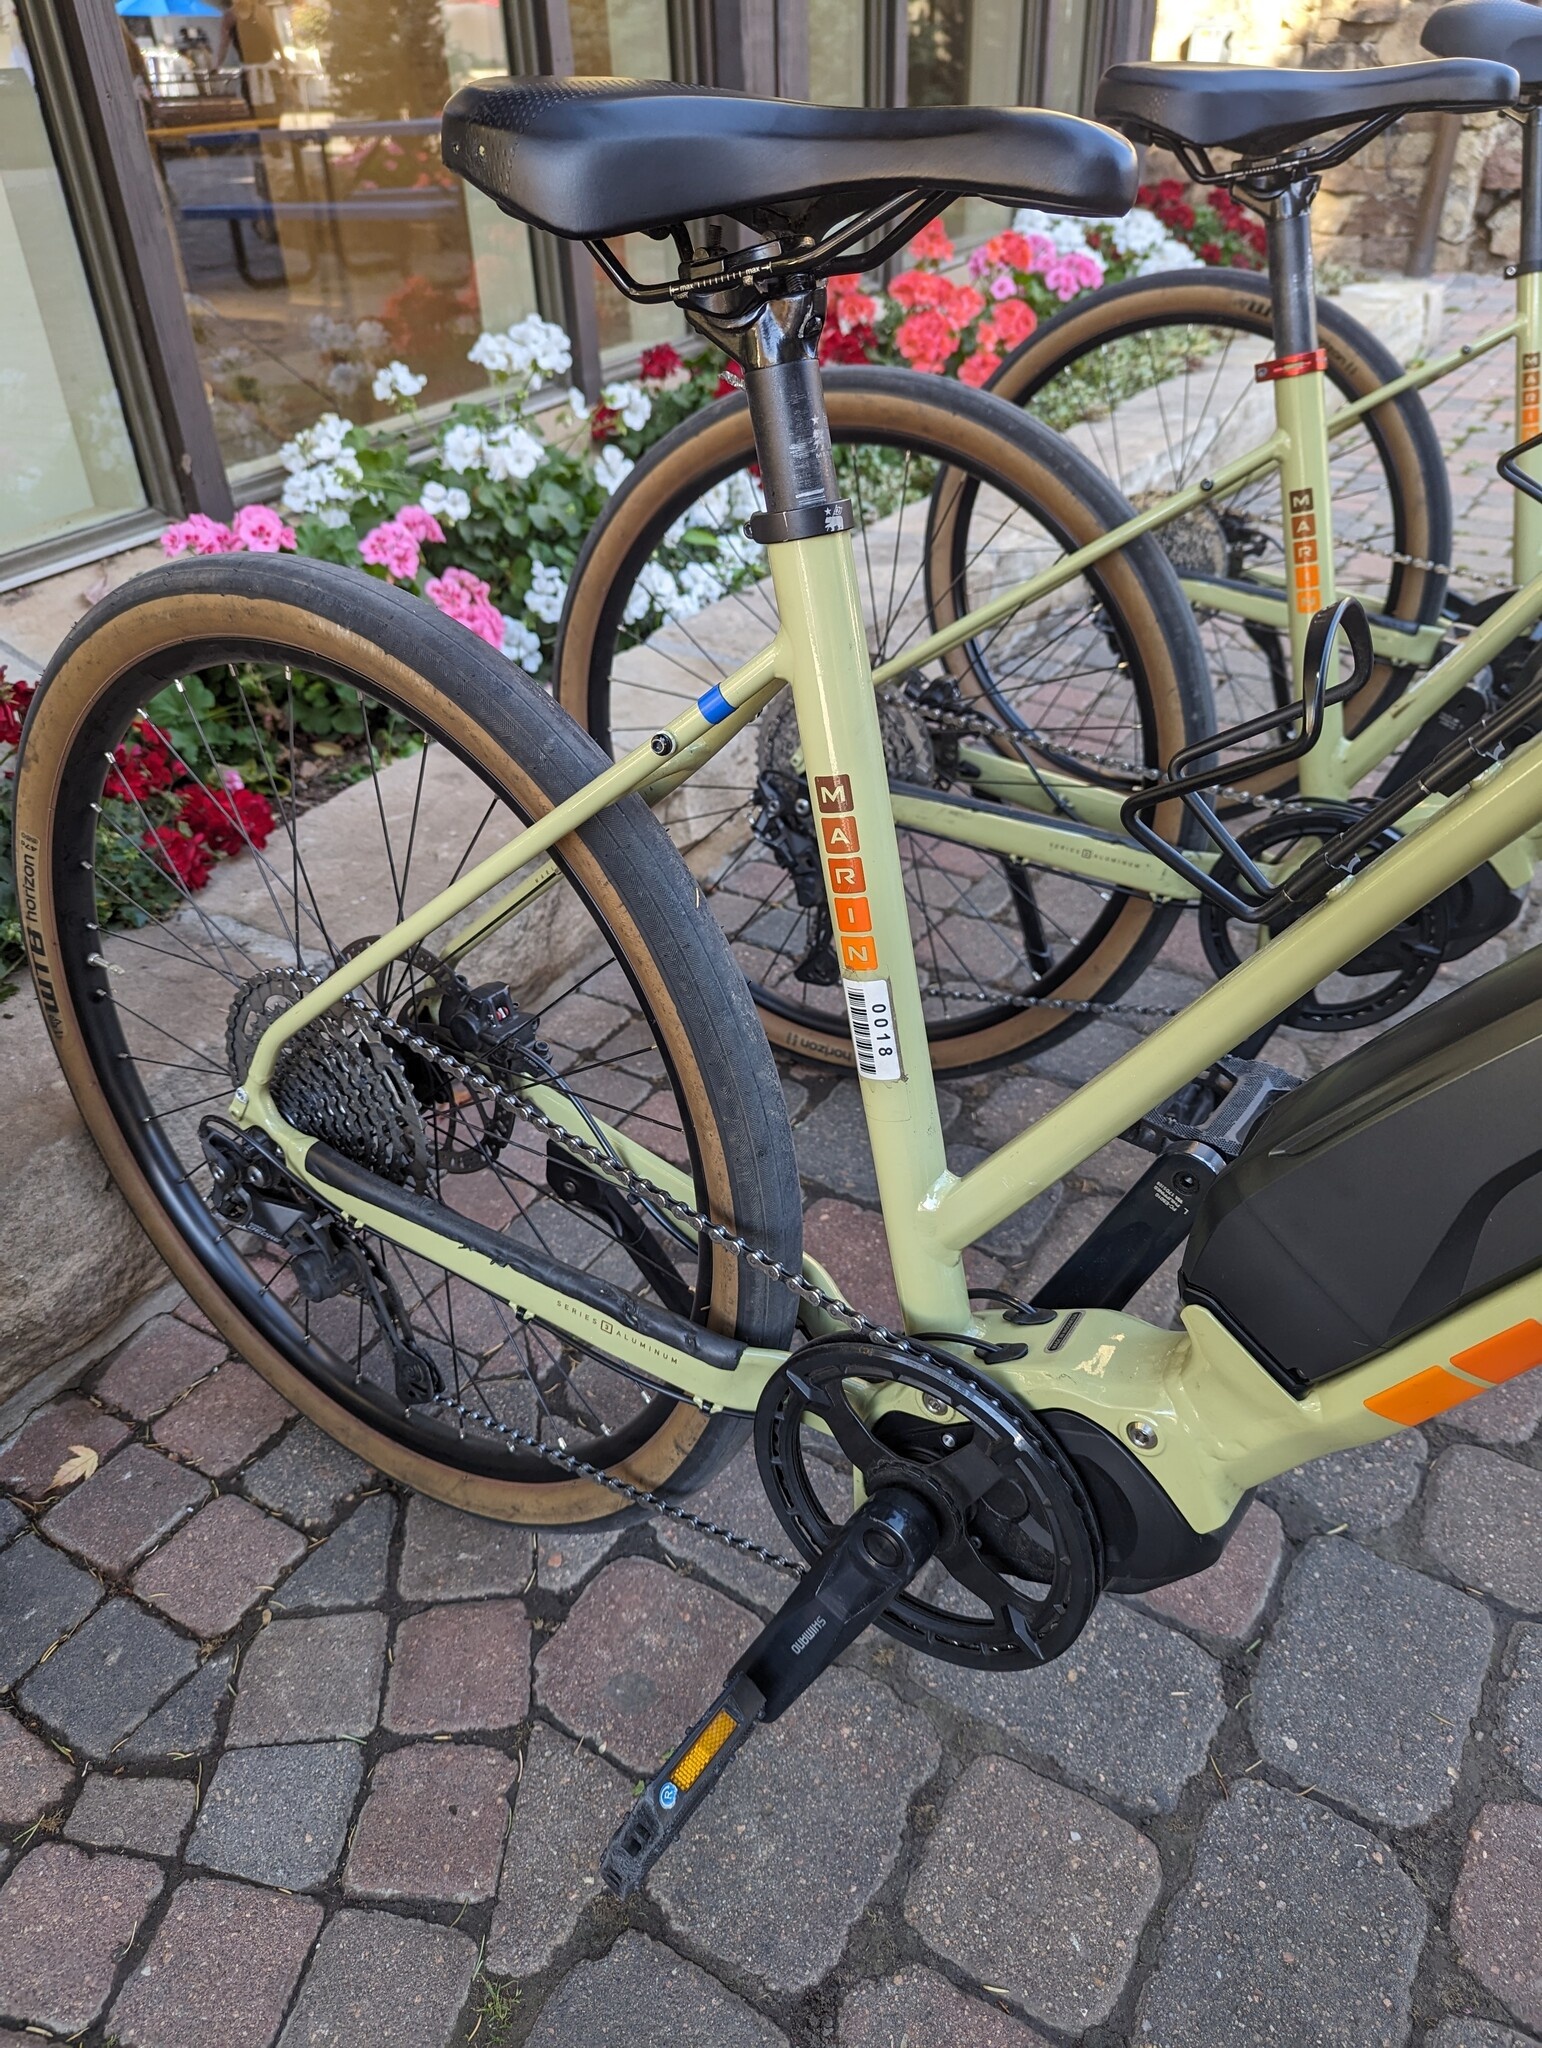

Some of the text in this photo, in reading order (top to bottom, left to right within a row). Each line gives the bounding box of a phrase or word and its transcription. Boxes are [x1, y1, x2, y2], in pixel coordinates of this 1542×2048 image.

[680, 266, 760, 292] max max
[819, 784, 870, 964] MARIN
[22, 853, 60, 1013] WTB horizon
[800, 1036, 854, 1061] horizon
[872, 1003, 893, 1058] 0018
[556, 1300, 598, 1326] SERIES
[616, 1330, 678, 1365] ALUMINUM
[790, 1615, 827, 1655] SHIMANO
